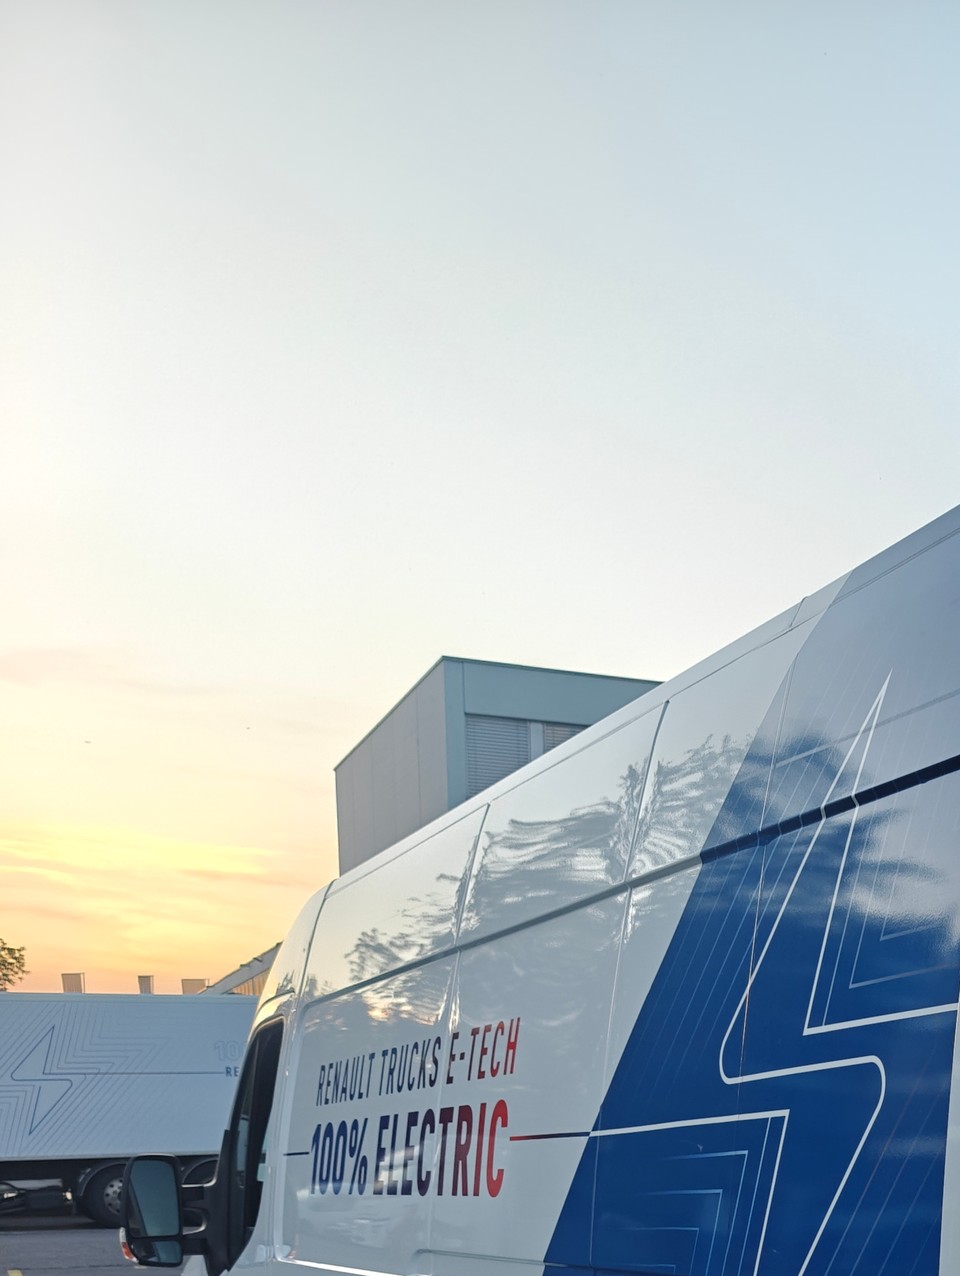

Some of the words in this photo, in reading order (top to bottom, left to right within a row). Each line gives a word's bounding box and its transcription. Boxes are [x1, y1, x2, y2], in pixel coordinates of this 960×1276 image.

[316, 1052, 376, 1106] RENAULT
[379, 1036, 441, 1096] TRUCKS
[446, 1017, 521, 1085] E-TECH
[310, 1117, 369, 1196] 100%
[373, 1099, 509, 1198] ELECTRIC
